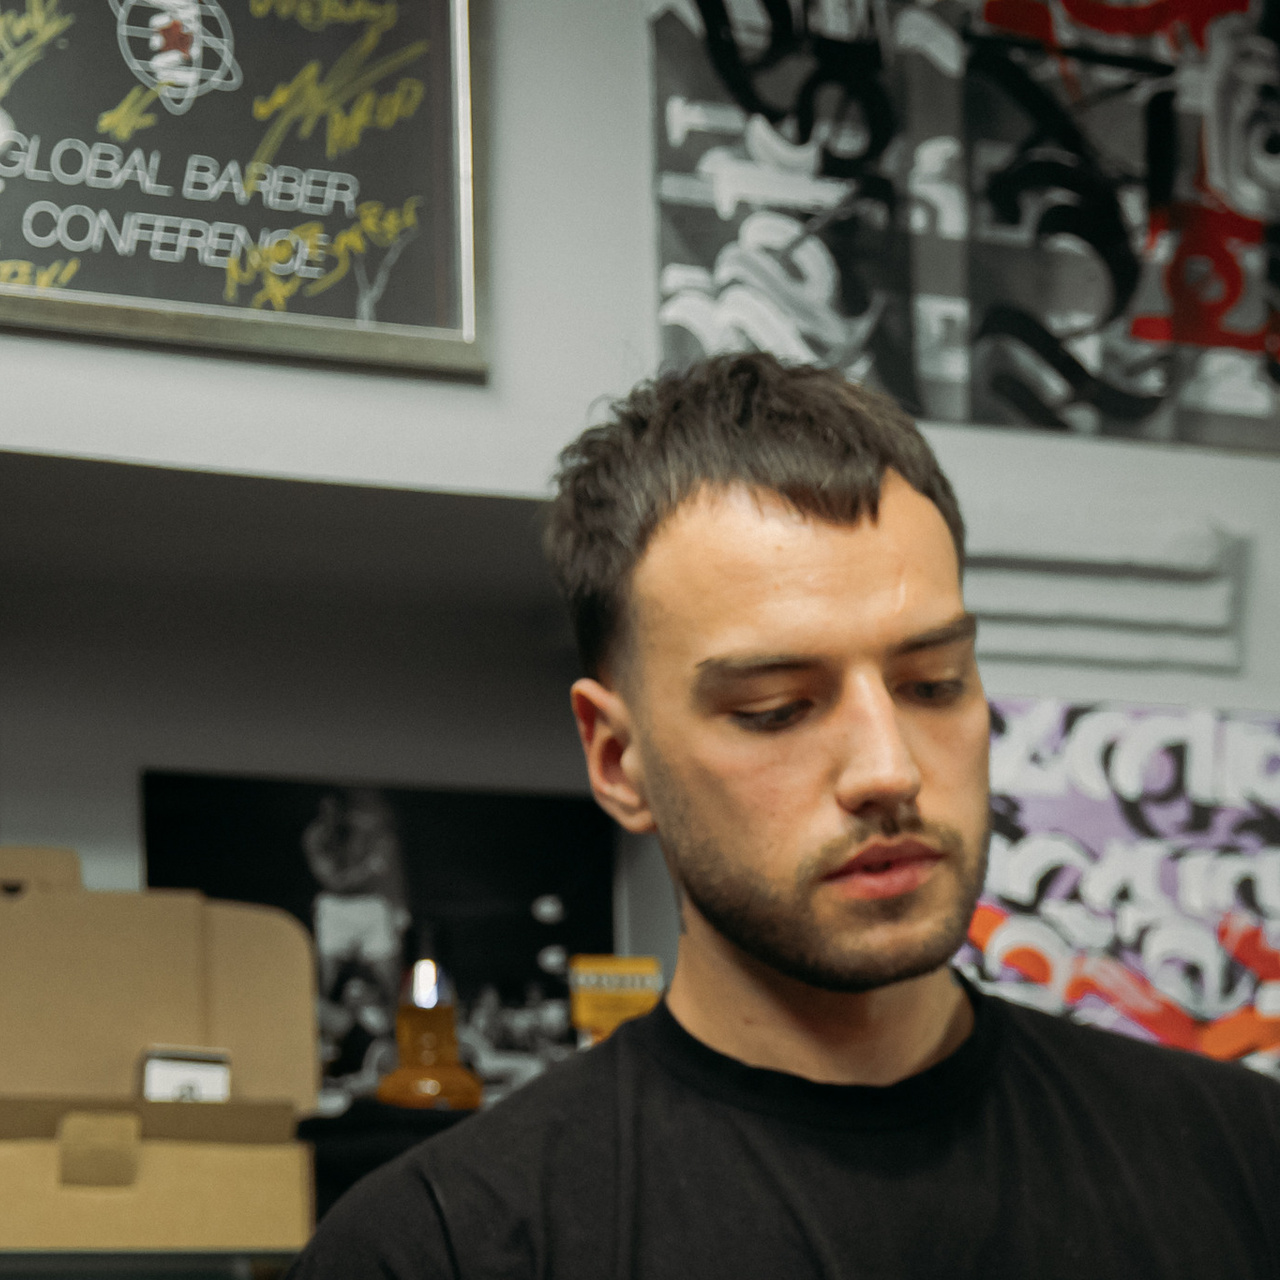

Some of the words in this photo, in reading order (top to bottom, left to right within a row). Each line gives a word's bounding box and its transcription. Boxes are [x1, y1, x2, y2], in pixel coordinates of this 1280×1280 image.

[0, 130, 174, 197] GLOBAL
[182, 153, 360, 217] BARBER
[22, 200, 330, 279] CONFERENCE
